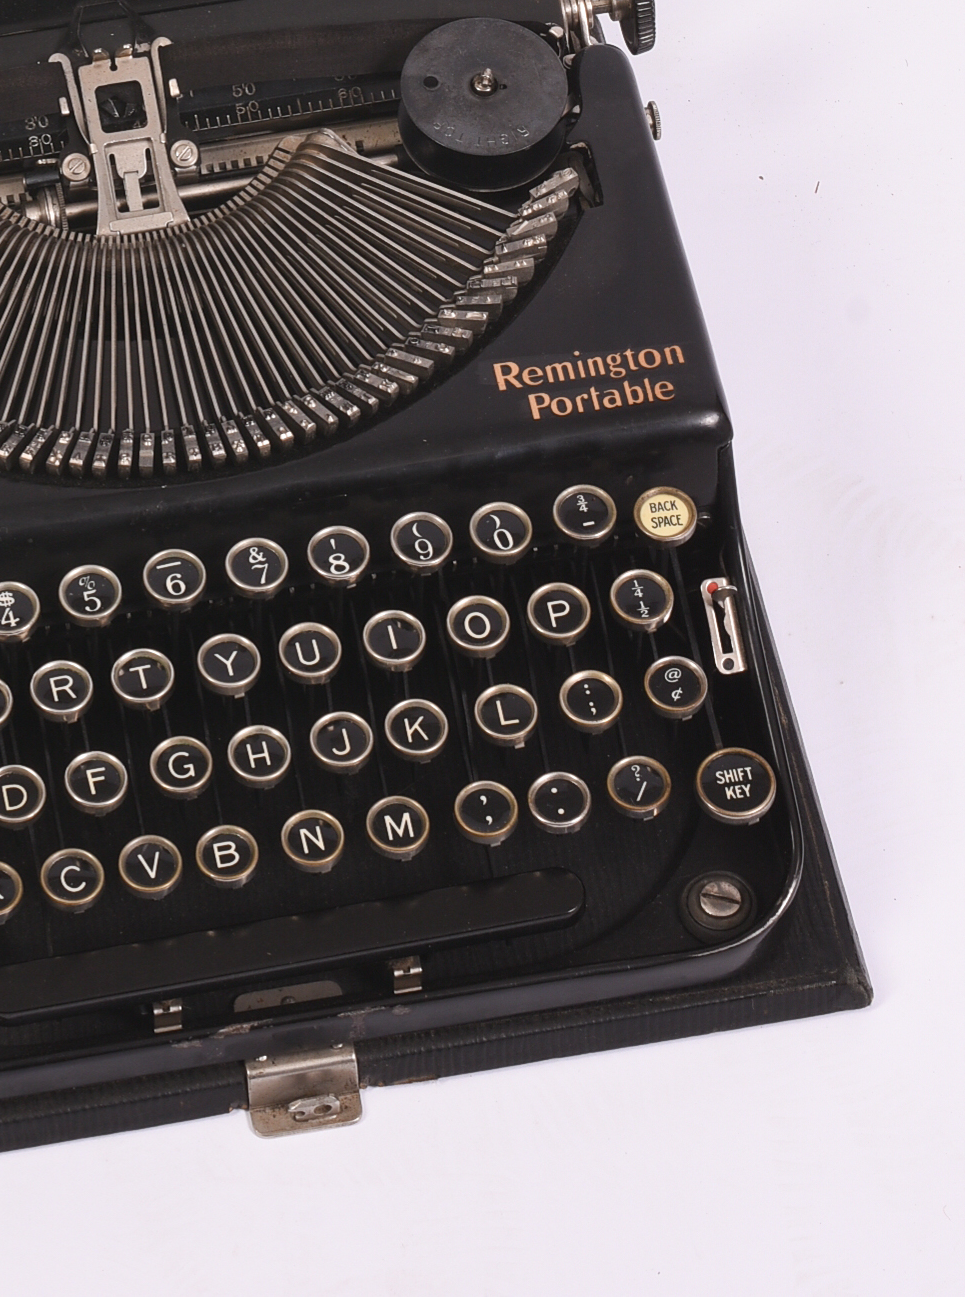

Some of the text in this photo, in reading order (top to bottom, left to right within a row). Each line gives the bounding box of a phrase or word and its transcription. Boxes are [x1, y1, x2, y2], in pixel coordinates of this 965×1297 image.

[236, 100, 259, 114] 50
[493, 344, 685, 391] Remington
[527, 377, 675, 420] Portable
[649, 500, 678, 513] BACK
[650, 514, 683, 529] SPACE
[0, 607, 20, 627] 4
[82, 589, 101, 612] 5
[165, 573, 186, 595] 6
[250, 563, 269, 584] 7
[328, 553, 350, 574] 8
[414, 539, 434, 560] 9
[48, 674, 77, 702] R
[129, 664, 151, 690] T
[214, 650, 238, 676] Y
[295, 639, 320, 666] U
[387, 624, 398, 650] I
[464, 611, 491, 639] O
[546, 599, 570, 628] P
[1, 784, 28, 811] D
[85, 767, 107, 795] F
[168, 752, 196, 779] G
[245, 741, 272, 769] H
[331, 728, 351, 756] J
[403, 716, 429, 743] K
[496, 699, 520, 726] L
[714, 766, 753, 784] SHIFT
[725, 784, 752, 800] KEY
[60, 866, 87, 893] C
[137, 851, 160, 879] V
[212, 841, 240, 869] B
[299, 826, 326, 854] N
[383, 812, 415, 841] M
